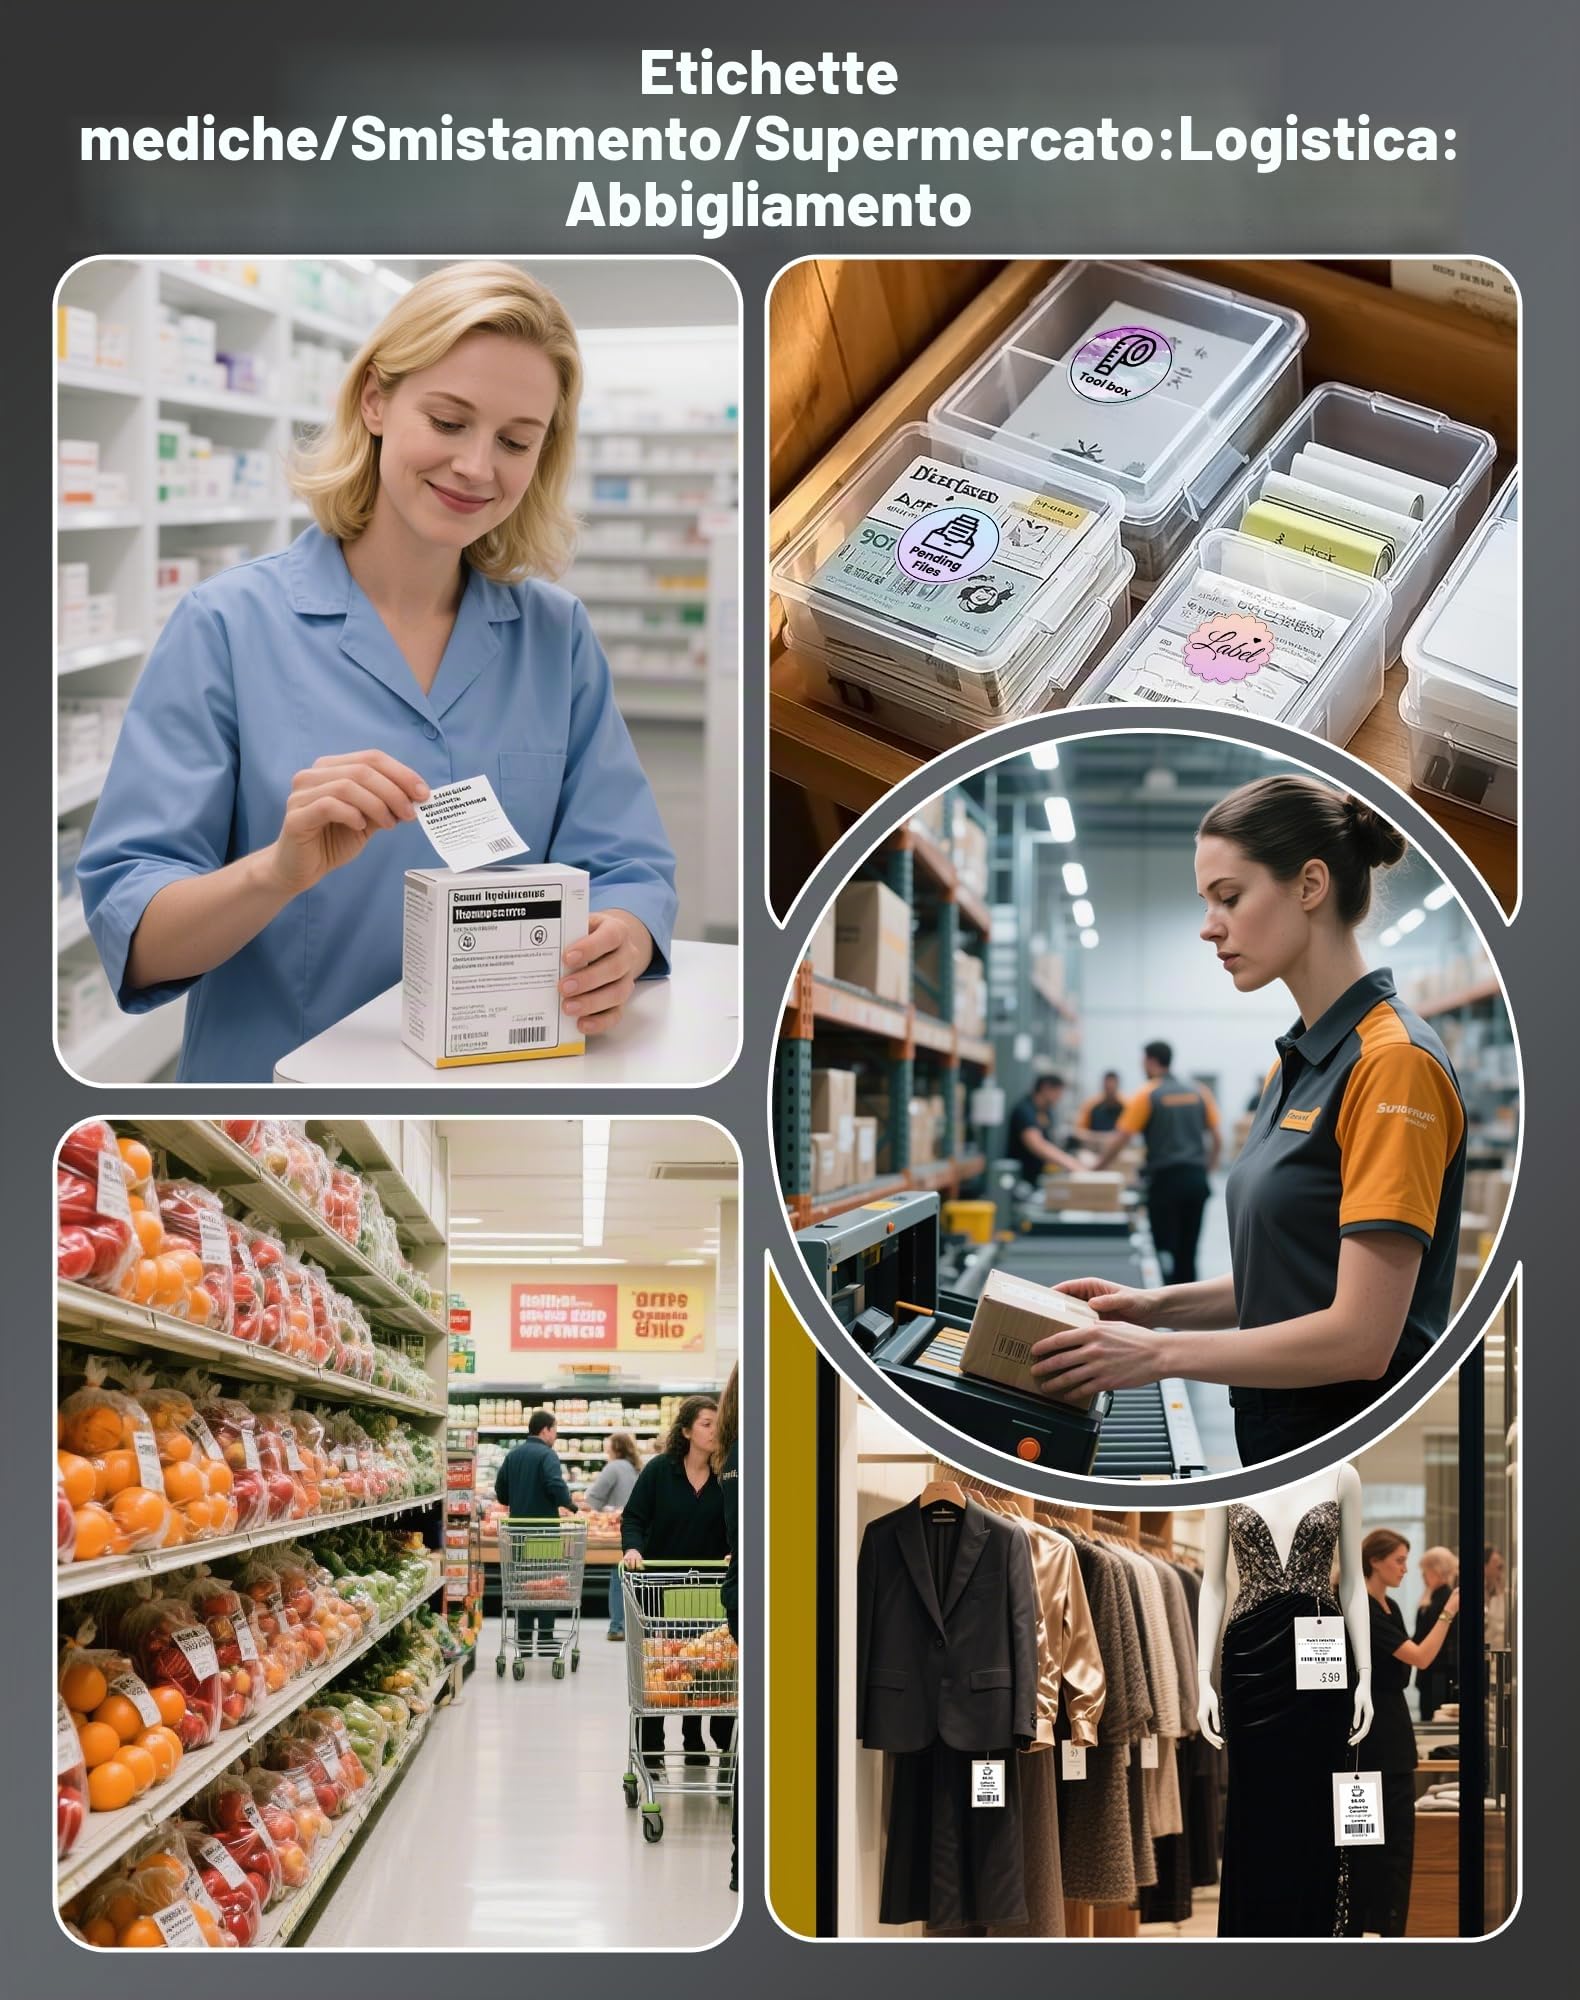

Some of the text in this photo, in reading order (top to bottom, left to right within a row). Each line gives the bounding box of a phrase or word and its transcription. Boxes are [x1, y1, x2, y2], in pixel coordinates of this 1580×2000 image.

[1080, 371, 1132, 397] Tool box
[908, 545, 962, 573] Pending
[911, 560, 942, 577] Files
[1191, 630, 1266, 664] Label
